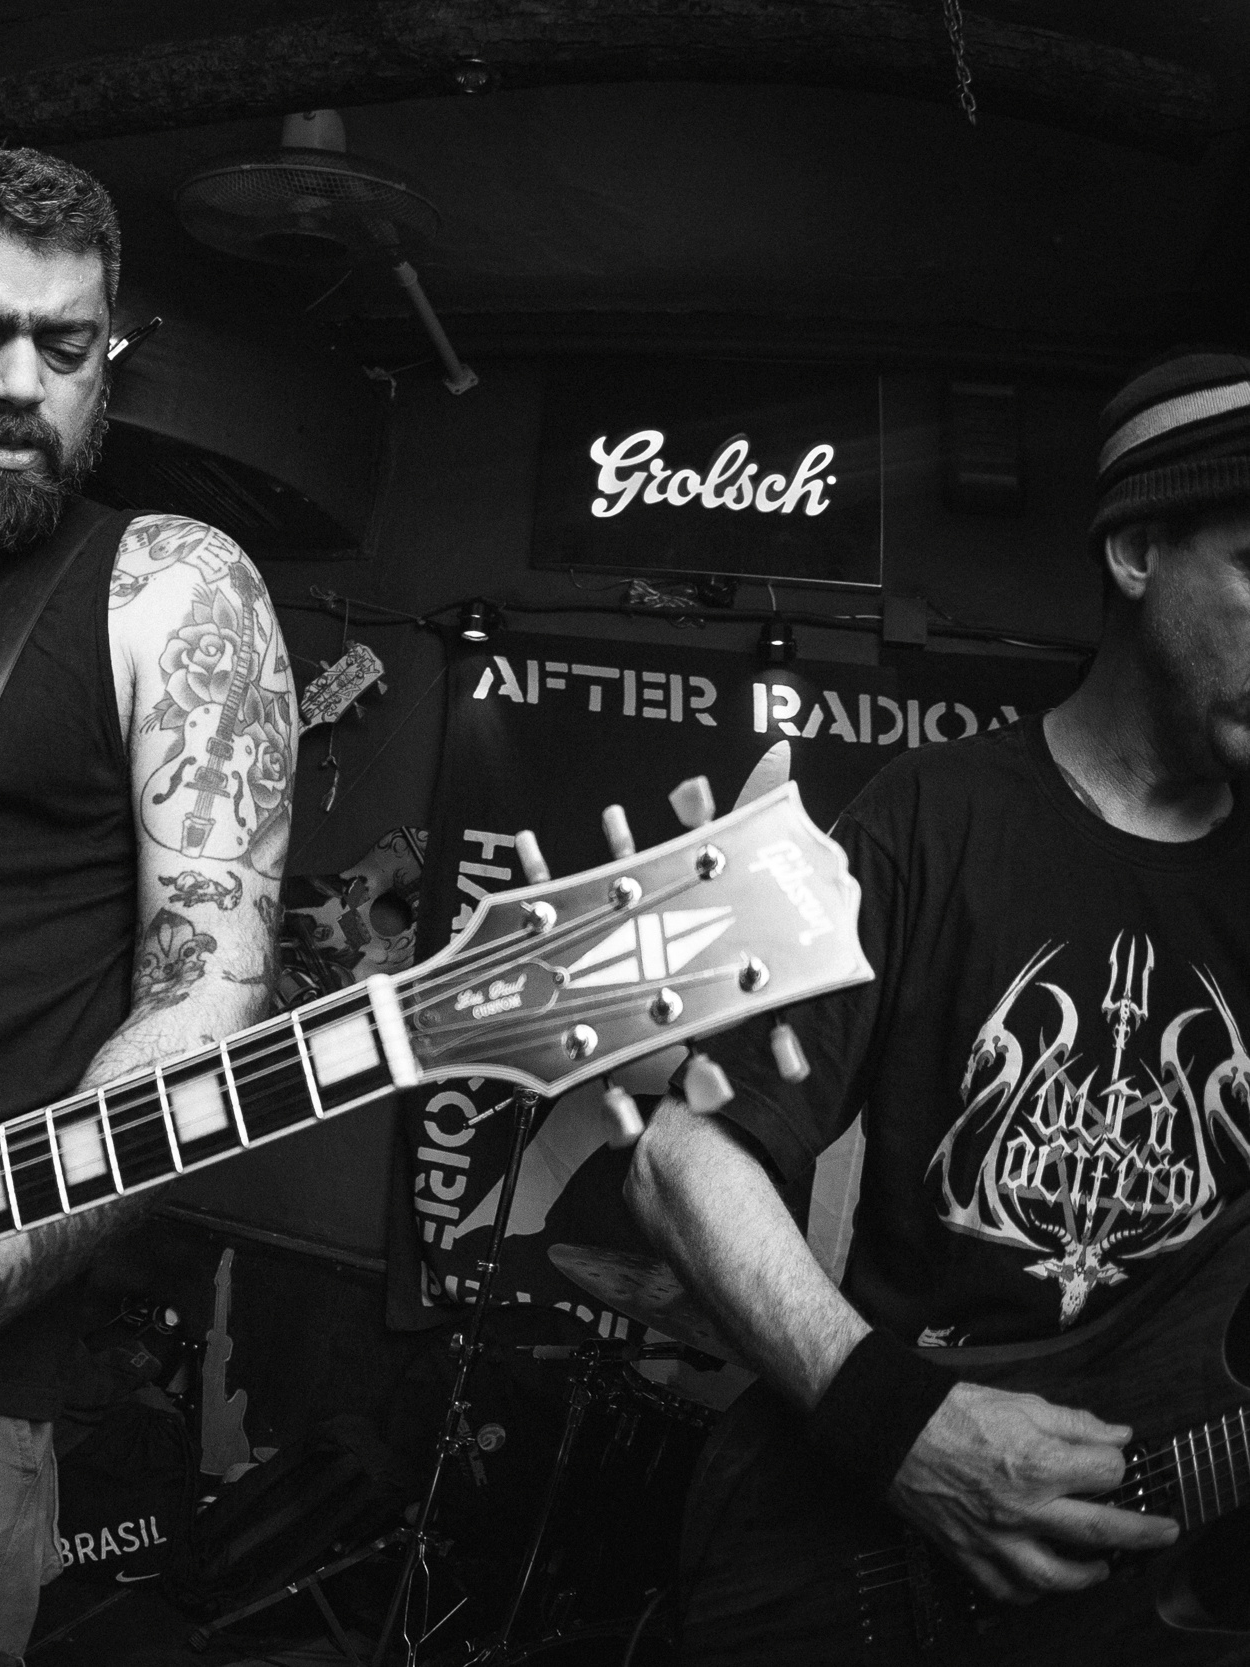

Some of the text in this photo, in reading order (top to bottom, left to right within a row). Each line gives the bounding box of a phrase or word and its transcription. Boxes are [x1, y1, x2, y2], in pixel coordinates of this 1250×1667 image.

[590, 429, 837, 517] Grolsch
[472, 656, 718, 727] AFTER
[488, 973, 528, 1000] Paul
[60, 1515, 167, 1567] BRASIL
